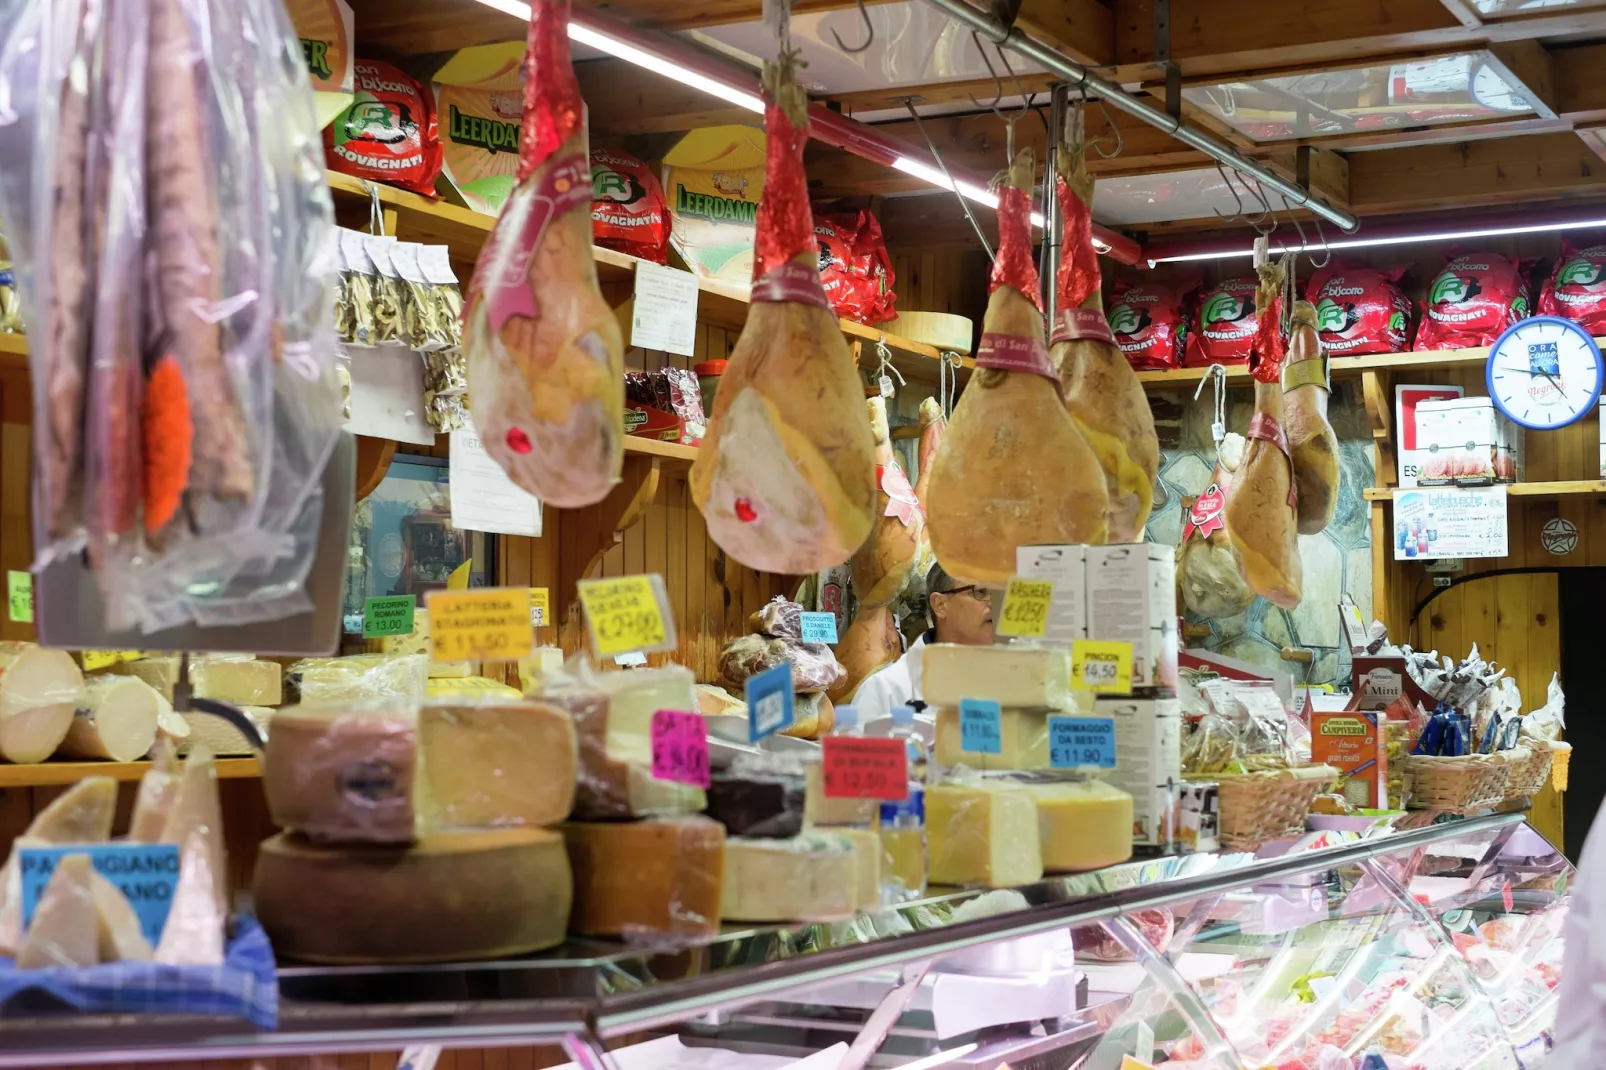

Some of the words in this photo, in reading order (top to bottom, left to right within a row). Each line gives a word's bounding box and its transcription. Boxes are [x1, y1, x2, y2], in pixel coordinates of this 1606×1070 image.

[449, 104, 520, 154] LEERDA
[333, 145, 423, 169] ROVAGNATI
[676, 183, 758, 226] LEERDAMM
[591, 211, 658, 226] OVAGNATI
[1428, 308, 1487, 321] ROVAGNATI
[1120, 338, 1157, 352] AGNATI
[1320, 336, 1368, 350] OVAGNATI
[1529, 343, 1557, 352] ORA
[1530, 351, 1557, 359] come
[371, 600, 410, 610] PECORINO
[374, 609, 406, 618] ROMANO
[802, 615, 834, 623] PROSCIUTTO
[376, 619, 402, 631] 13.00
[1371, 686, 1398, 695] Mini
[1052, 723, 1111, 734] FORMAGGIO
[1321, 726, 1365, 735] CAMPIVERDI
[1058, 736, 1072, 745] DA
